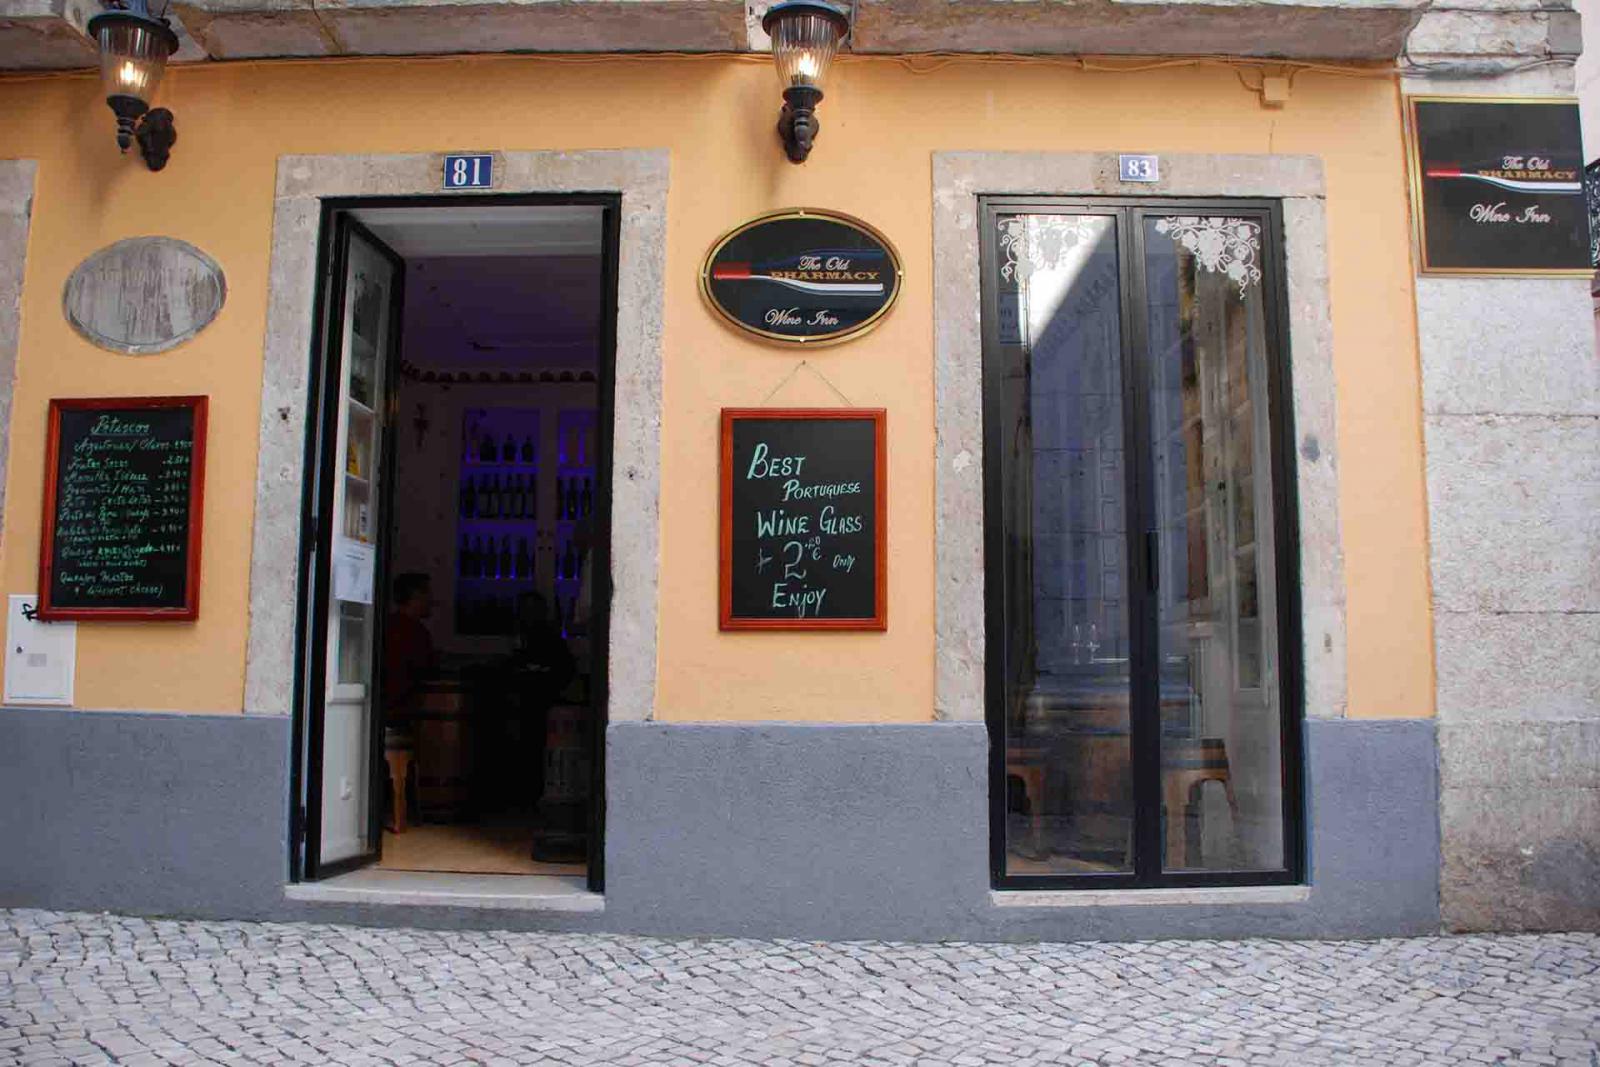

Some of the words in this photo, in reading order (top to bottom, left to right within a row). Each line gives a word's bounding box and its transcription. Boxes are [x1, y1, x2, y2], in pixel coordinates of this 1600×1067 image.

[453, 158, 481, 186] 81
[1128, 159, 1152, 177] 83
[1502, 155, 1524, 171] The
[1477, 170, 1577, 180] PHARMACY
[1469, 201, 1511, 223] Wine
[1515, 205, 1552, 223] Inn
[797, 255, 821, 271] The
[825, 255, 851, 271] Old
[769, 270, 880, 280] PHARMACY
[764, 307, 802, 326] Wine
[806, 309, 839, 326] Inn
[746, 442, 806, 480] BEST
[782, 479, 862, 502] PORTUGUESE
[819, 505, 863, 535] GLASS
